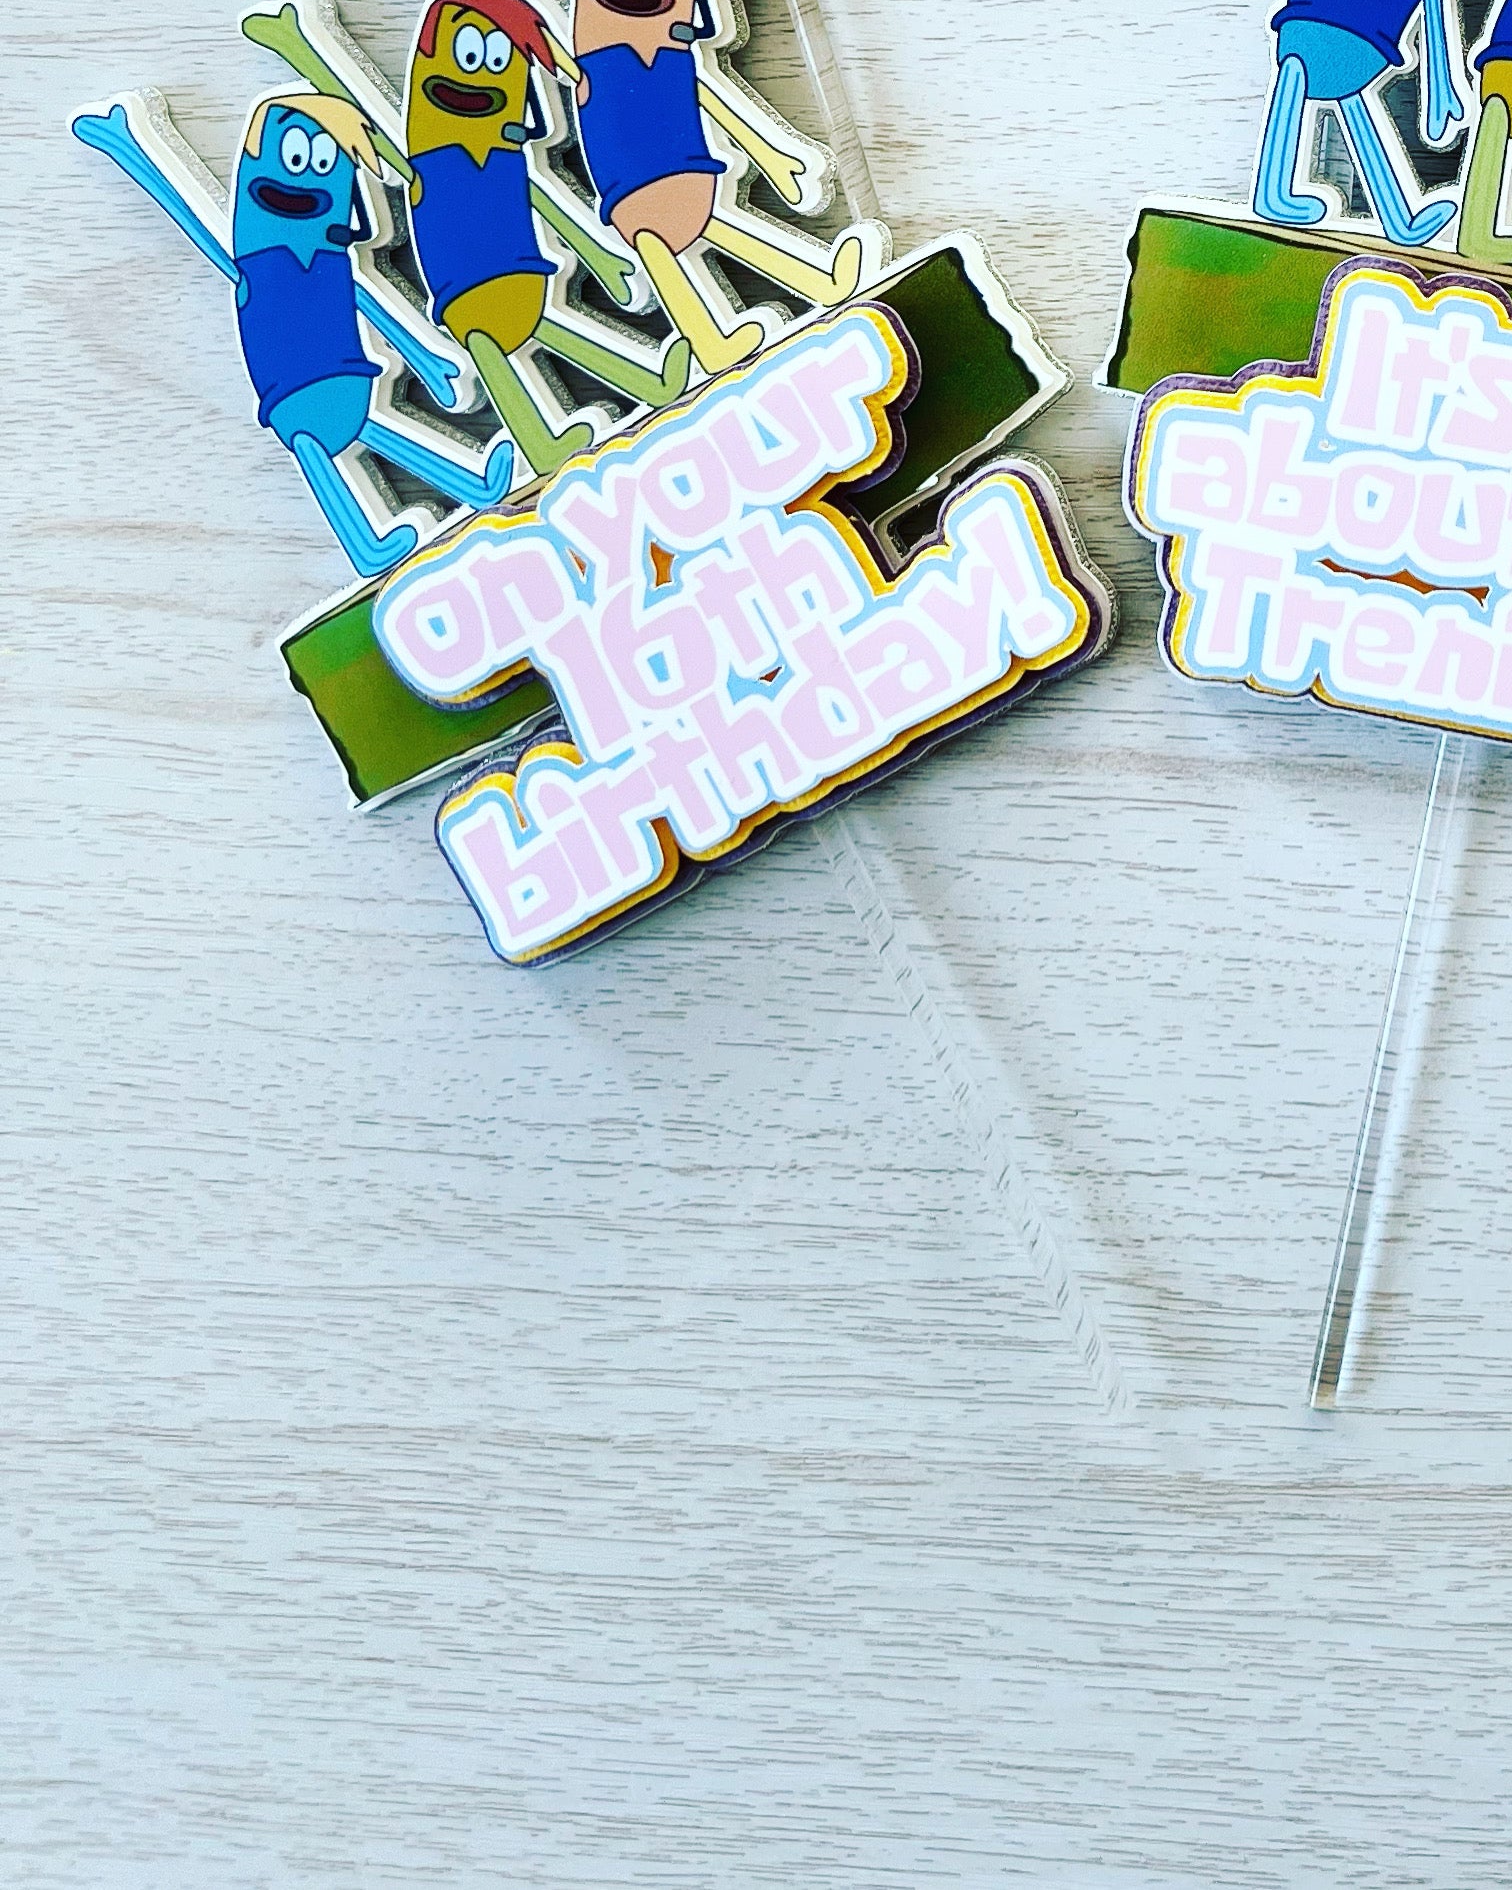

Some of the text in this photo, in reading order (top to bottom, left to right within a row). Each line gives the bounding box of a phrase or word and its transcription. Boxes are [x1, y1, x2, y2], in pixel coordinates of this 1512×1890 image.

[560, 338, 891, 588] your
[463, 508, 1058, 940] birthday!
[543, 520, 861, 750] 16th
